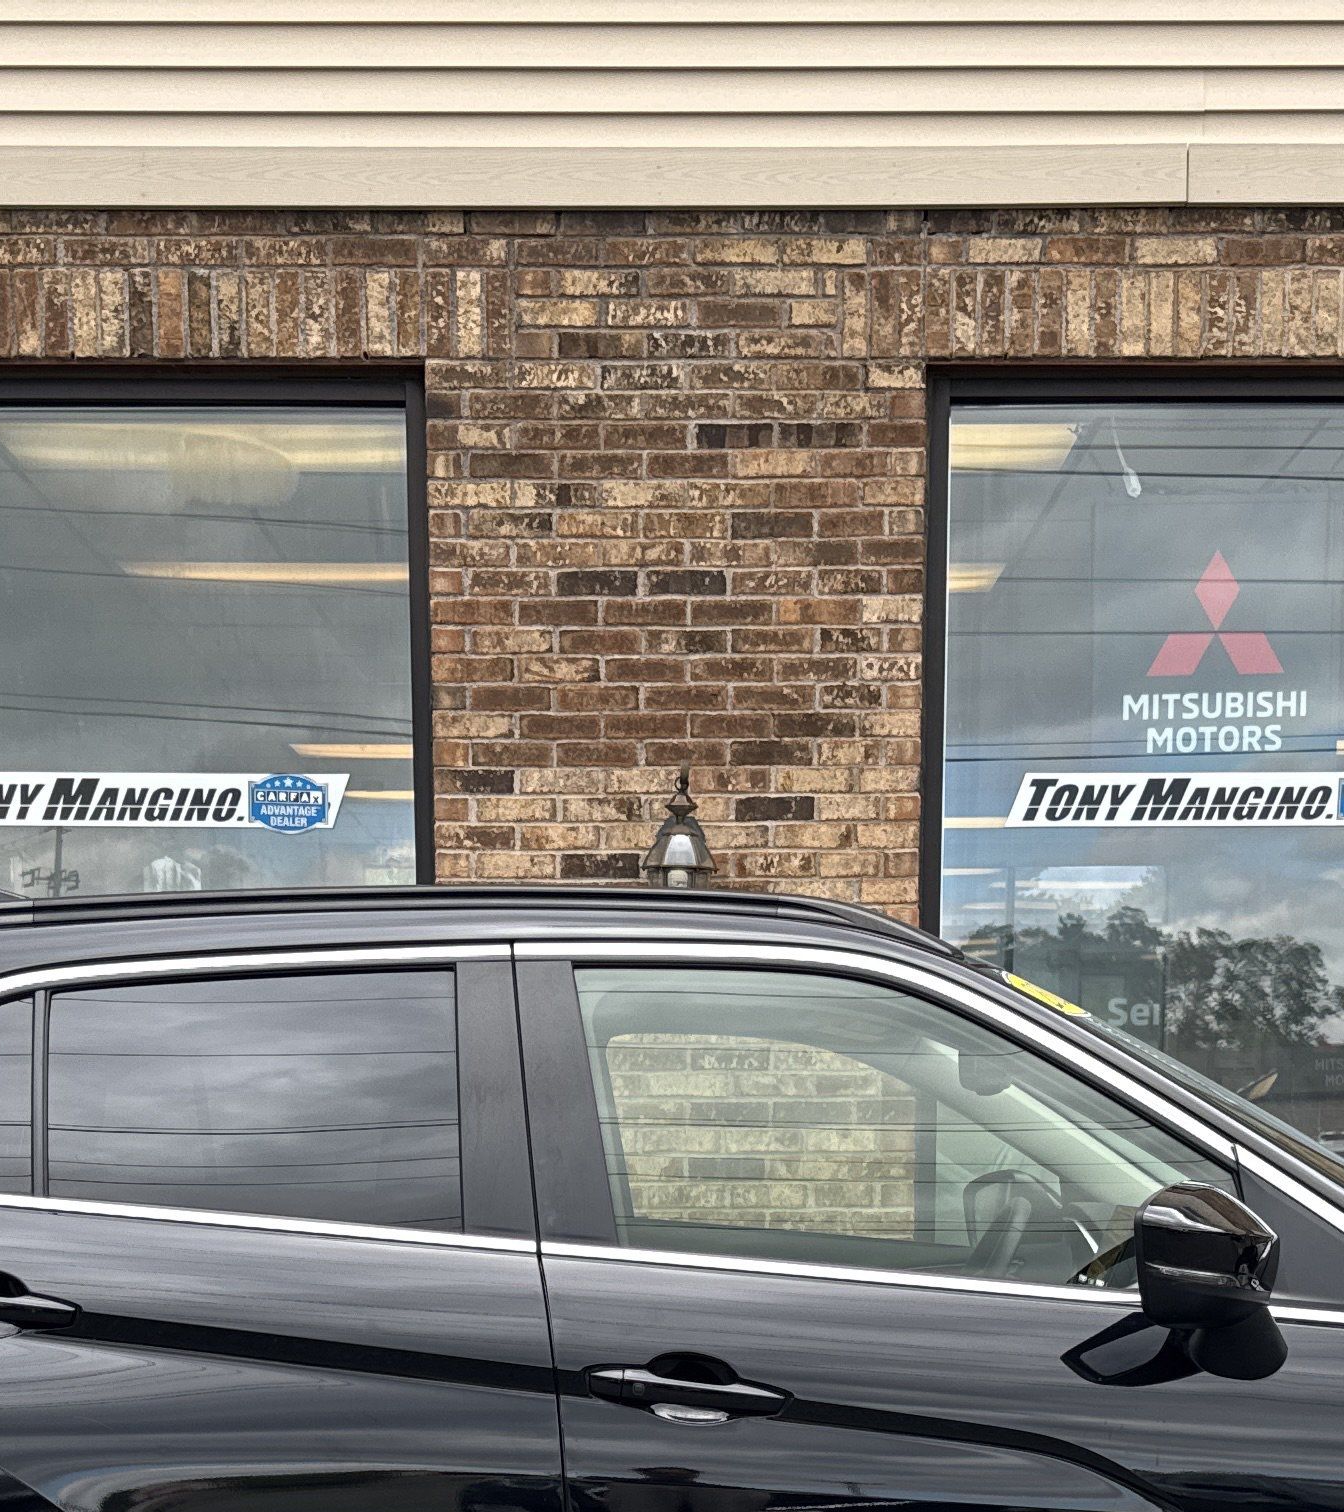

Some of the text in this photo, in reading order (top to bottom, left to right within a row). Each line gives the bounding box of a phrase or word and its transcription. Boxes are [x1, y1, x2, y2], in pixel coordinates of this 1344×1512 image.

[1122, 691, 1307, 721] MITSUBISHI
[1146, 724, 1283, 753] MOTORS
[256, 790, 323, 804] CARFAX
[1022, 778, 1137, 821] TONY
[270, 816, 308, 827] DEALER
